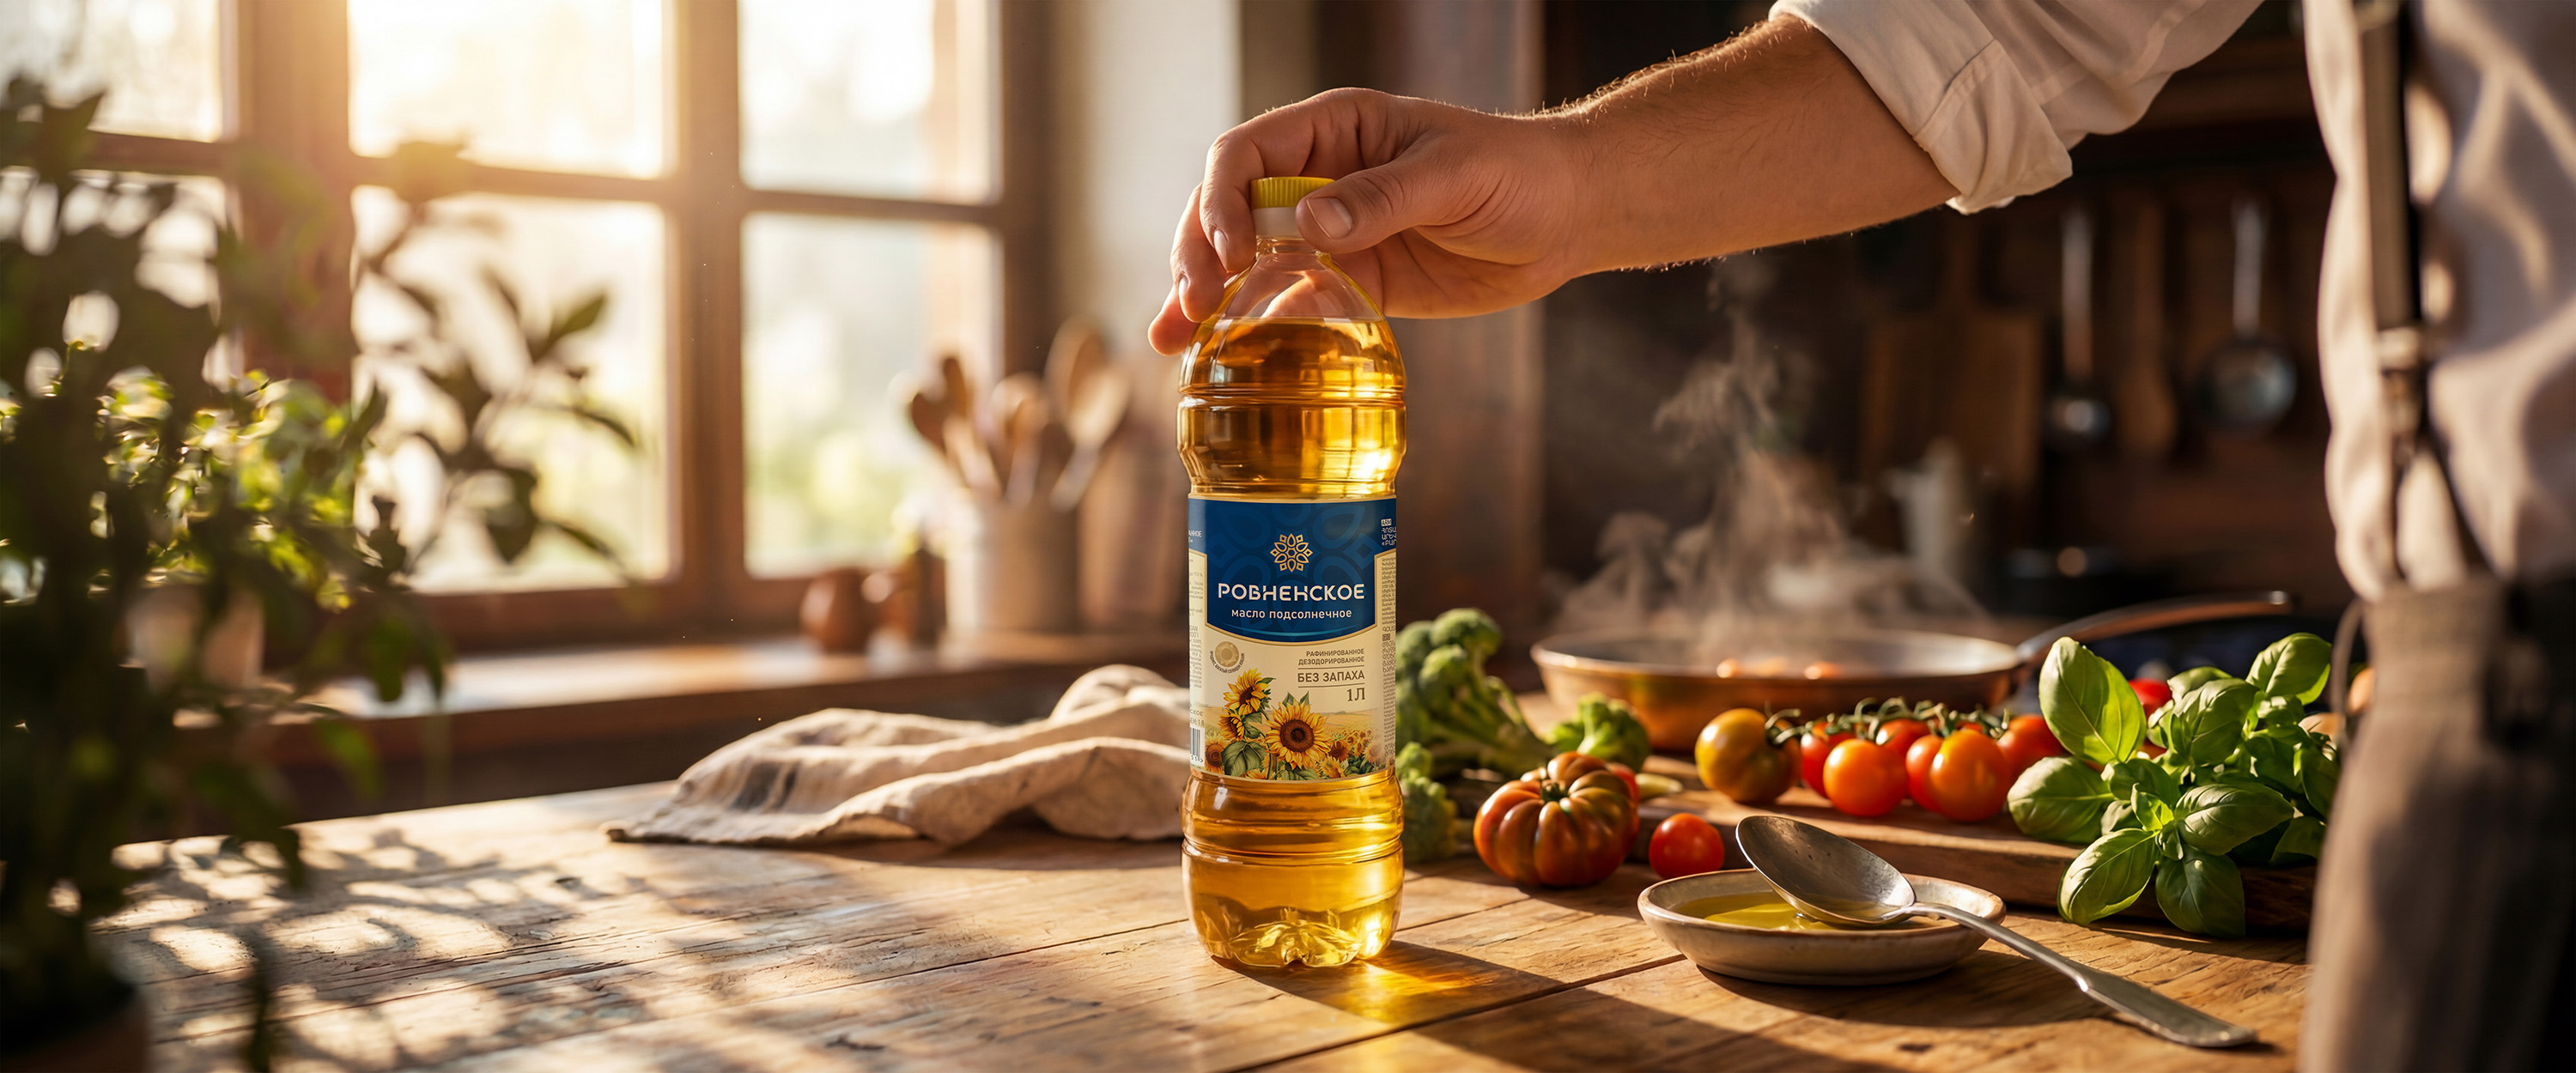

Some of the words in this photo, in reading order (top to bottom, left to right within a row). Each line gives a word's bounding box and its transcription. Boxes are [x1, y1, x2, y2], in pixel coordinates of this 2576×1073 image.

[1218, 583, 1365, 602] РОВНЕНСКОЕ
[1231, 609, 1266, 618] масло
[1269, 610, 1352, 620] подсолнечное
[1306, 648, 1364, 657] РАФИНИРОВАННОЕ
[1298, 657, 1364, 665] ДЕЗОДОРИРОВАННОЕ
[1297, 672, 1320, 682] БЕЗ
[1323, 670, 1365, 682] ЗАПАХА
